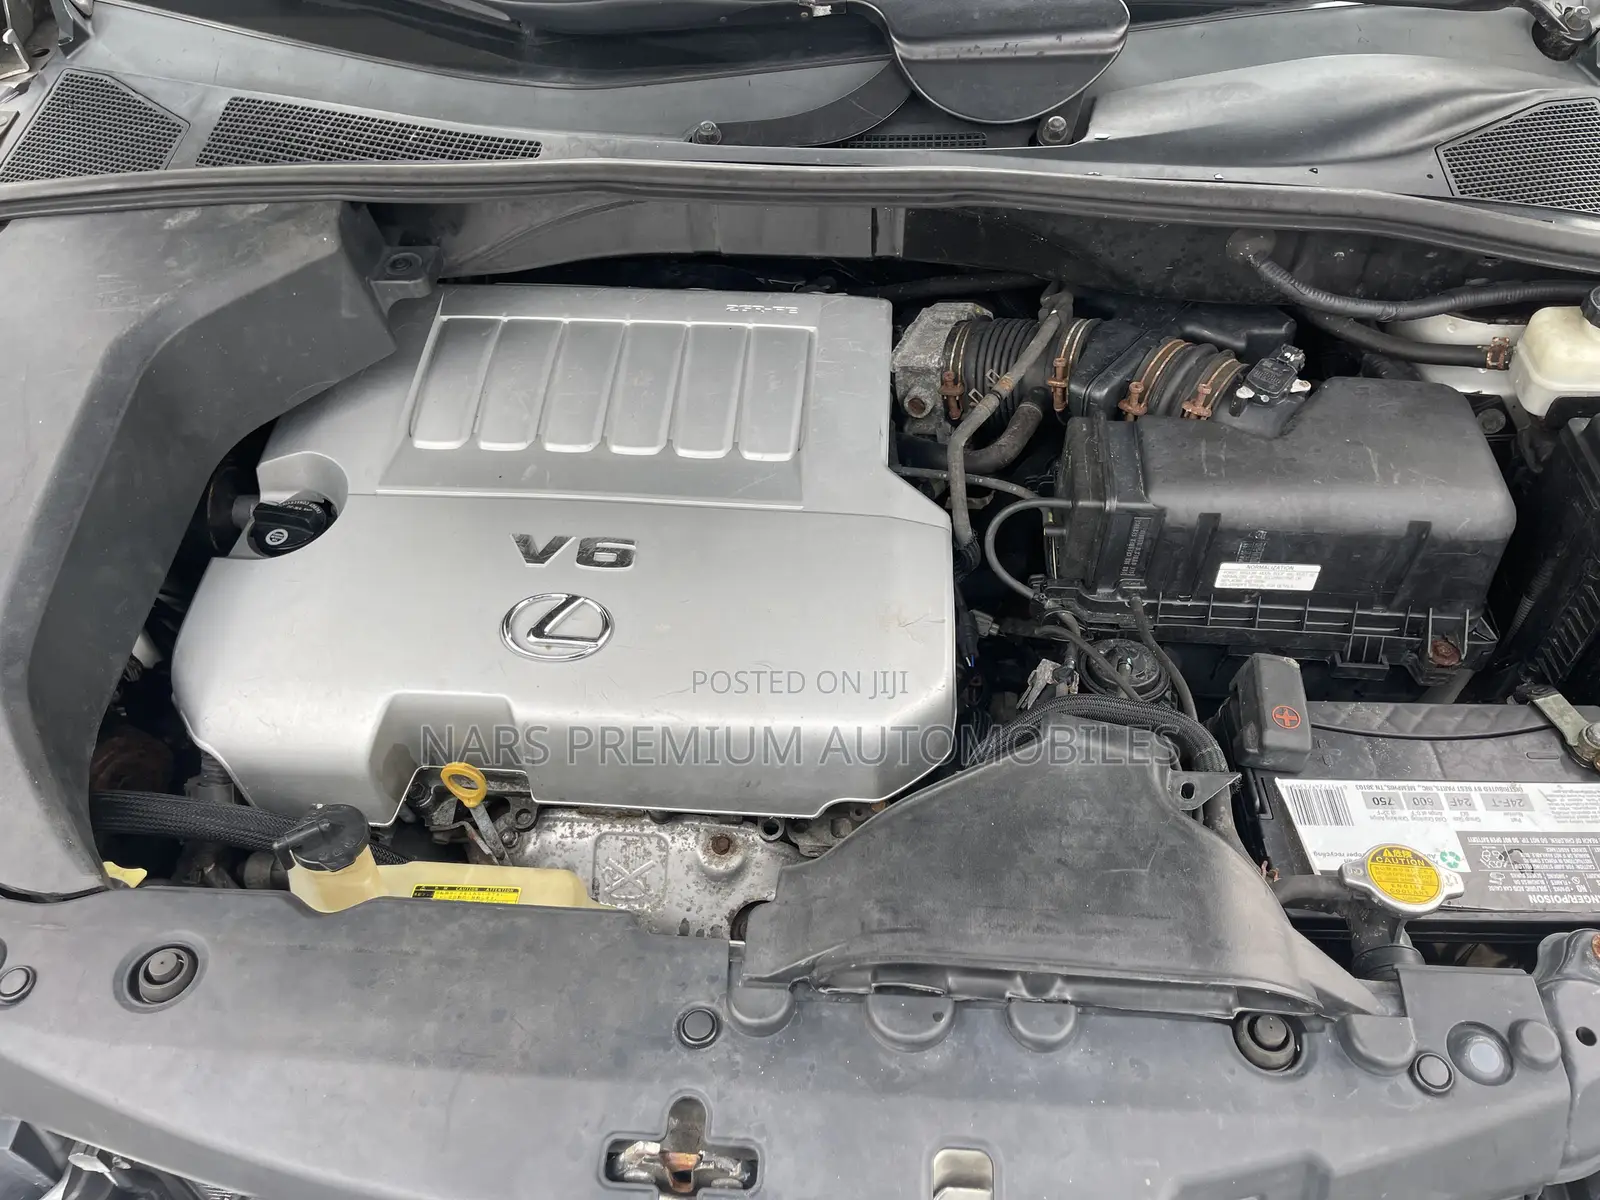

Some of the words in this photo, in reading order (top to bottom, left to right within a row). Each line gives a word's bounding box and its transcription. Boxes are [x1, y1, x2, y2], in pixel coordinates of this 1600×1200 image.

[509, 533, 637, 571] V6
[1372, 796, 1393, 806] 750
[1412, 797, 1433, 805] 600
[1449, 797, 1472, 807] 24F
[1492, 798, 1525, 808] 24F-T
[1375, 857, 1425, 866] CAUTION
[1576, 884, 1588, 892] NO
